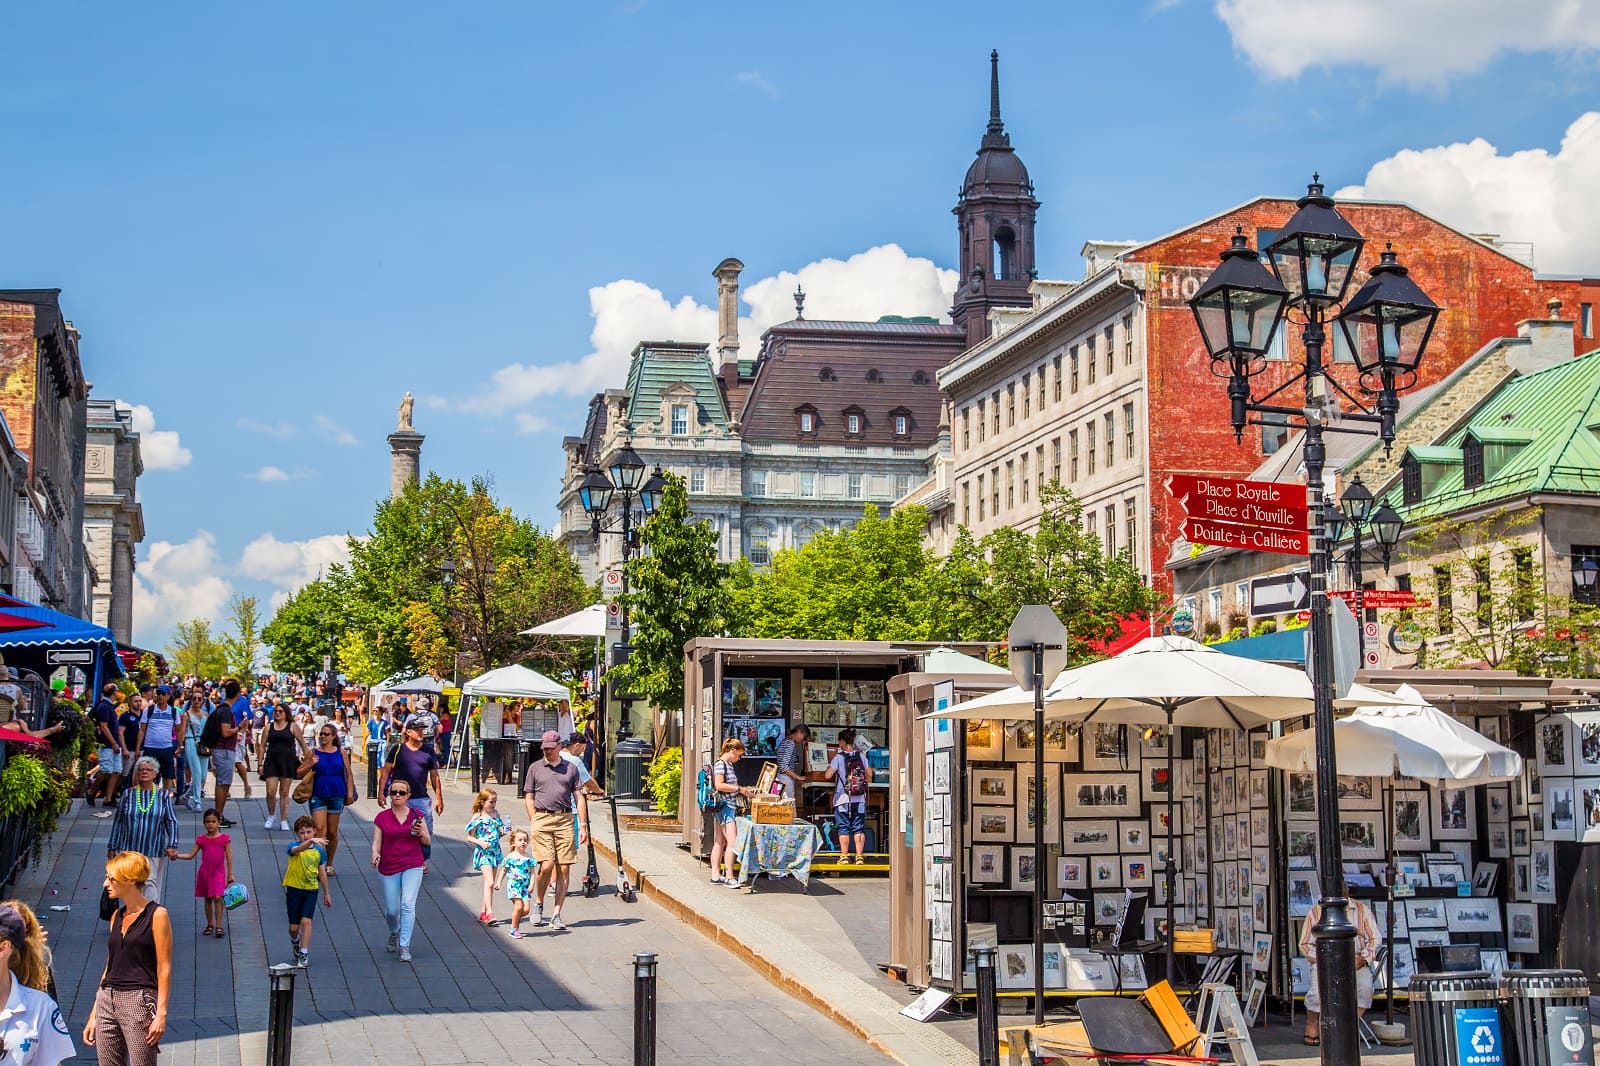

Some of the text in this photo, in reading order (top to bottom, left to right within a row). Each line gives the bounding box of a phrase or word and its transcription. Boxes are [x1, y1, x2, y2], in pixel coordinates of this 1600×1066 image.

[1197, 480, 1281, 502] Place Royale
[1206, 499, 1295, 525] Place d'Youville
[1193, 523, 1302, 550] Pointe-à-Callière
